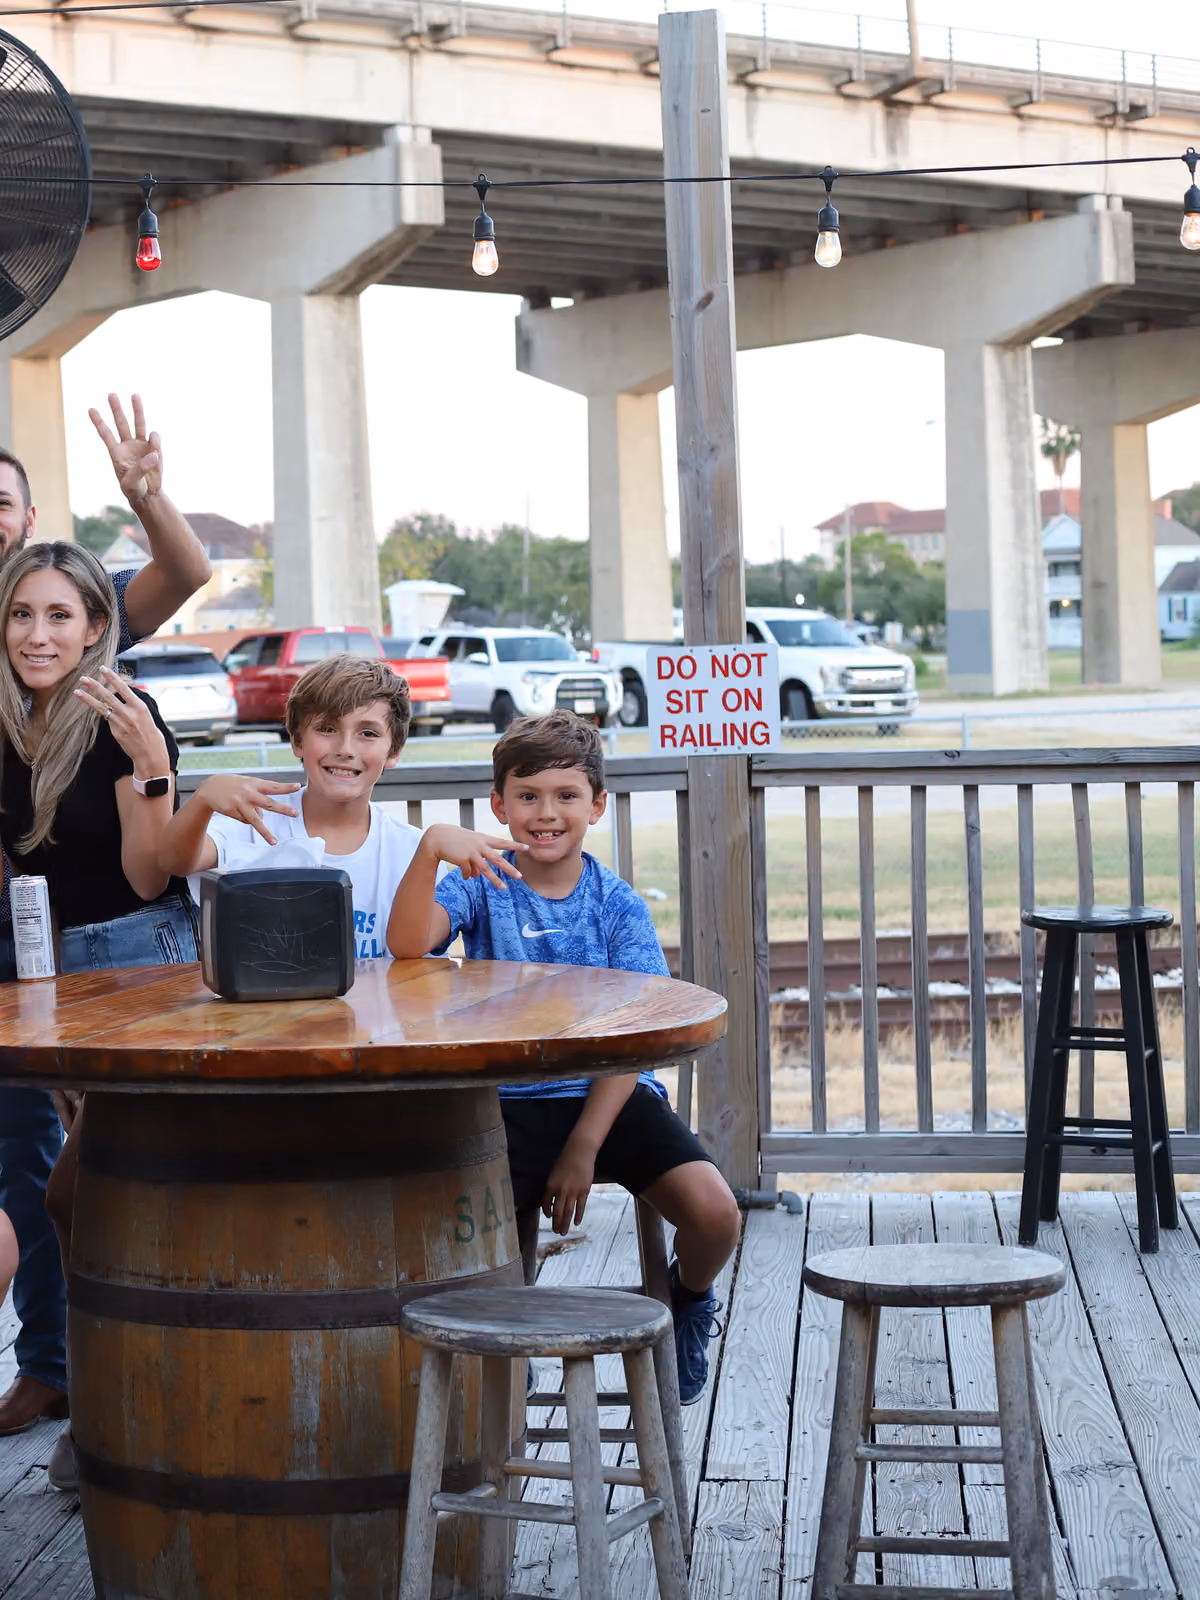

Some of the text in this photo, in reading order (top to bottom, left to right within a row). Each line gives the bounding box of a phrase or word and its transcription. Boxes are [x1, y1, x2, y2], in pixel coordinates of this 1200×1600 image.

[657, 653, 768, 680] DO NOT
[665, 687, 763, 714] SIT ON
[660, 721, 770, 748] RAILING
